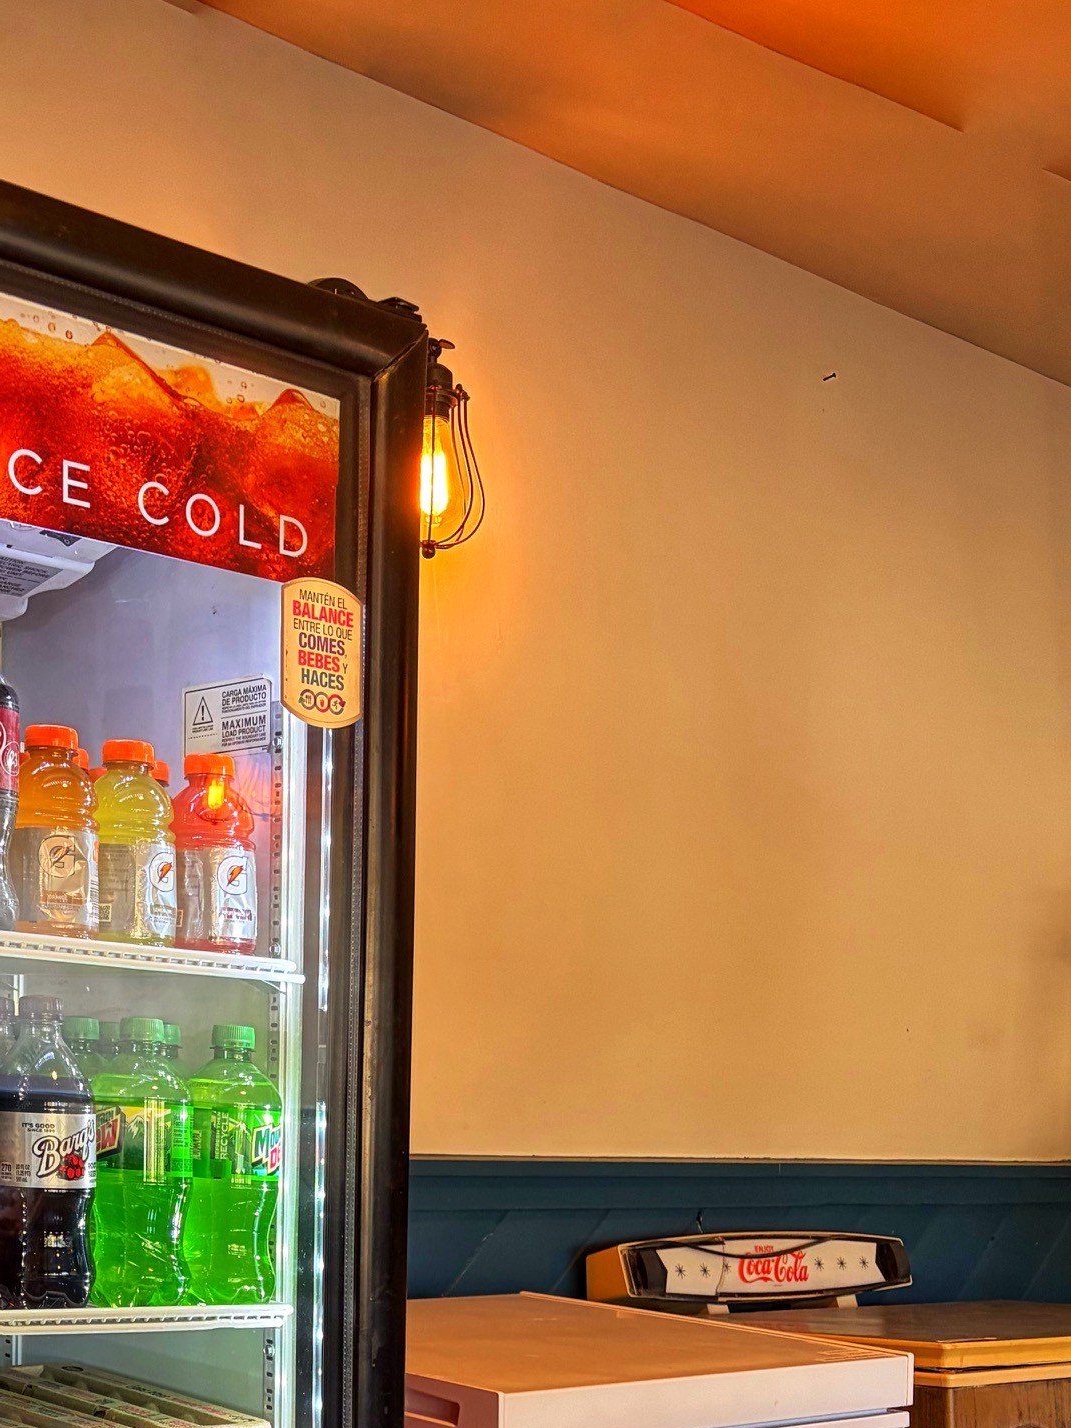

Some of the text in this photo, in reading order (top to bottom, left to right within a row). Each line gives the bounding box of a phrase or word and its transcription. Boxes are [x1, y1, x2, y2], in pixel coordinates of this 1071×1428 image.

[138, 481, 308, 558] COLD
[299, 589, 347, 610] MANTÉN EL
[293, 600, 354, 628] BALANCE
[294, 618, 352, 641] ENTRE LO QUE
[299, 632, 347, 658] COMES,
[298, 649, 348, 674] BEBES Y
[301, 668, 344, 691] HACES
[222, 688, 242, 698] CARGA
[222, 698, 230, 706] DE
[232, 692, 266, 704] PRODUCTO
[222, 715, 266, 730] MAXIMUM
[222, 725, 266, 738] LOAD PRODUCT
[220, 1111, 229, 1160] RECYCLE
[32, 1119, 96, 1178] Barq's
[755, 1245, 774, 1253] ENJOY
[738, 1250, 809, 1284] Coca-Cola
